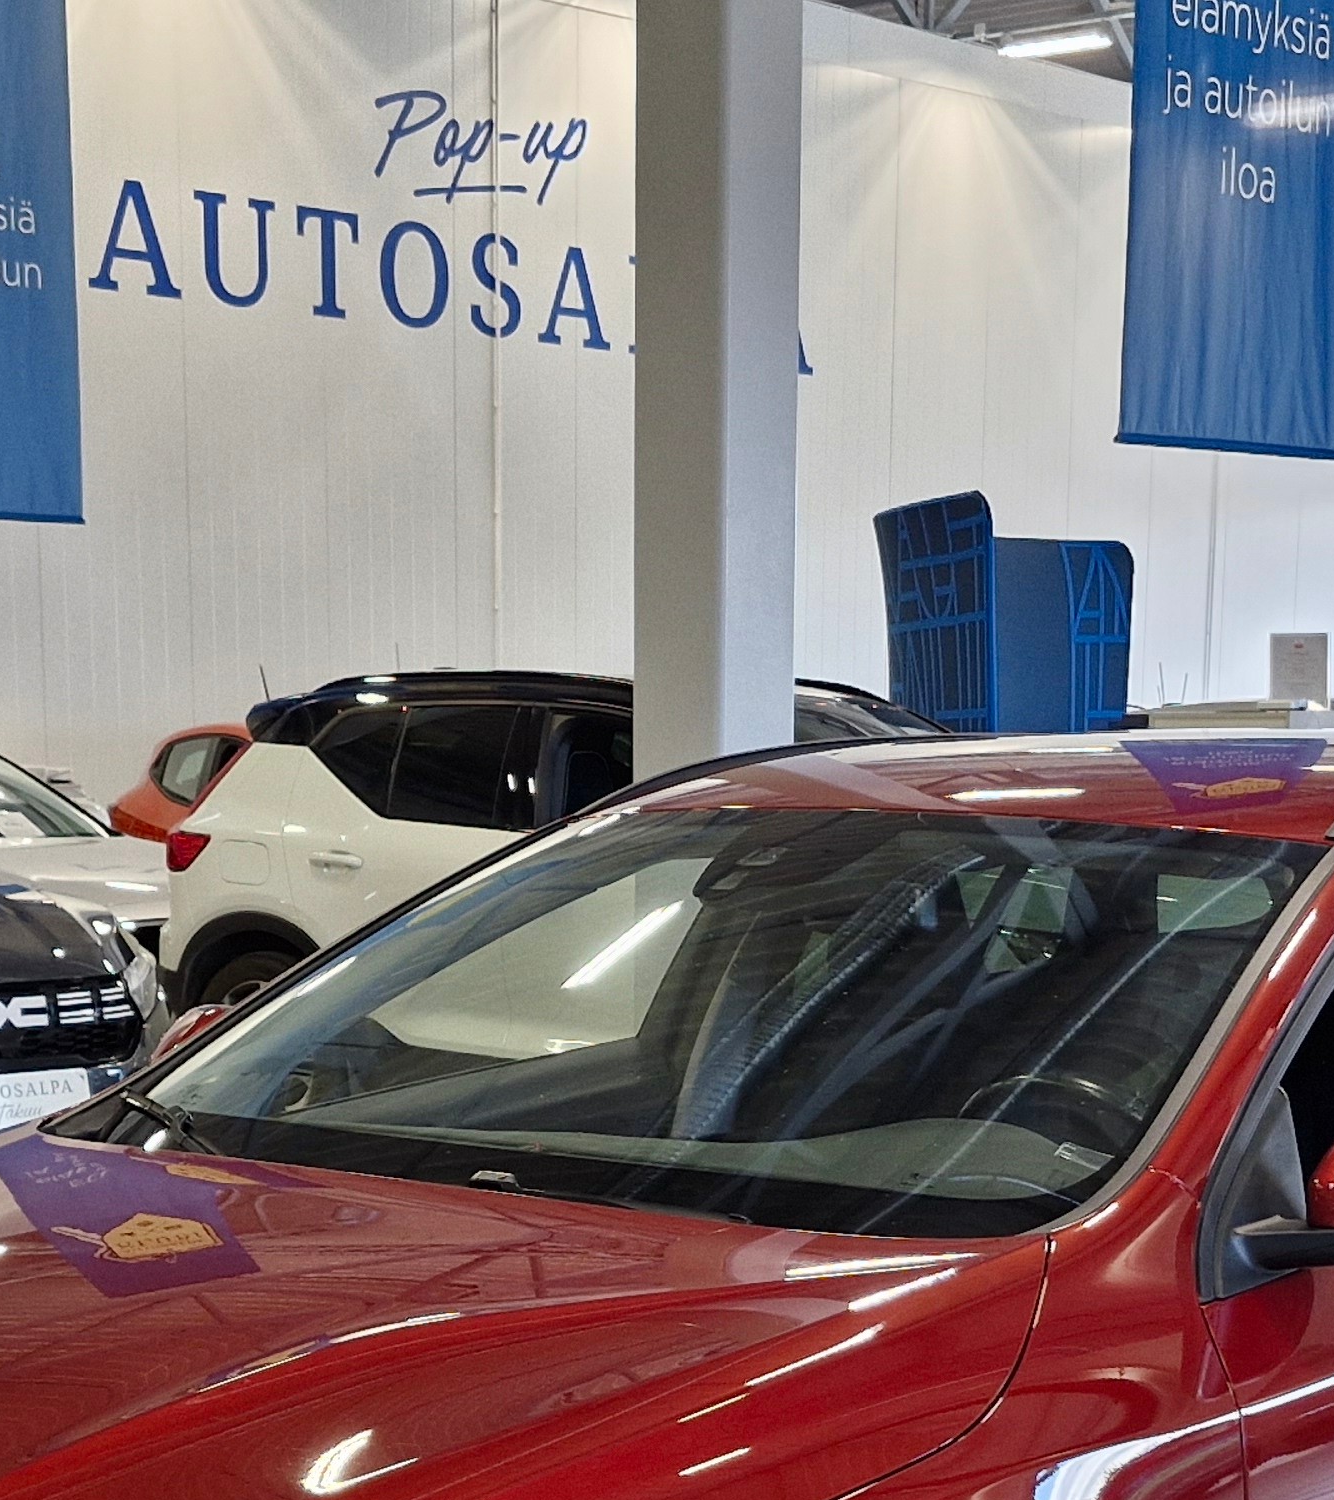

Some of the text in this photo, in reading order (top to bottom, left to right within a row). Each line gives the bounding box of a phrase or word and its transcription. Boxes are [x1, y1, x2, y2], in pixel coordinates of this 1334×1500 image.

[1163, 54, 1331, 137] ja autoilun
[375, 90, 587, 205] Pop-up
[1220, 146, 1275, 204] iloa
[88, 179, 814, 377] AUTOSA
